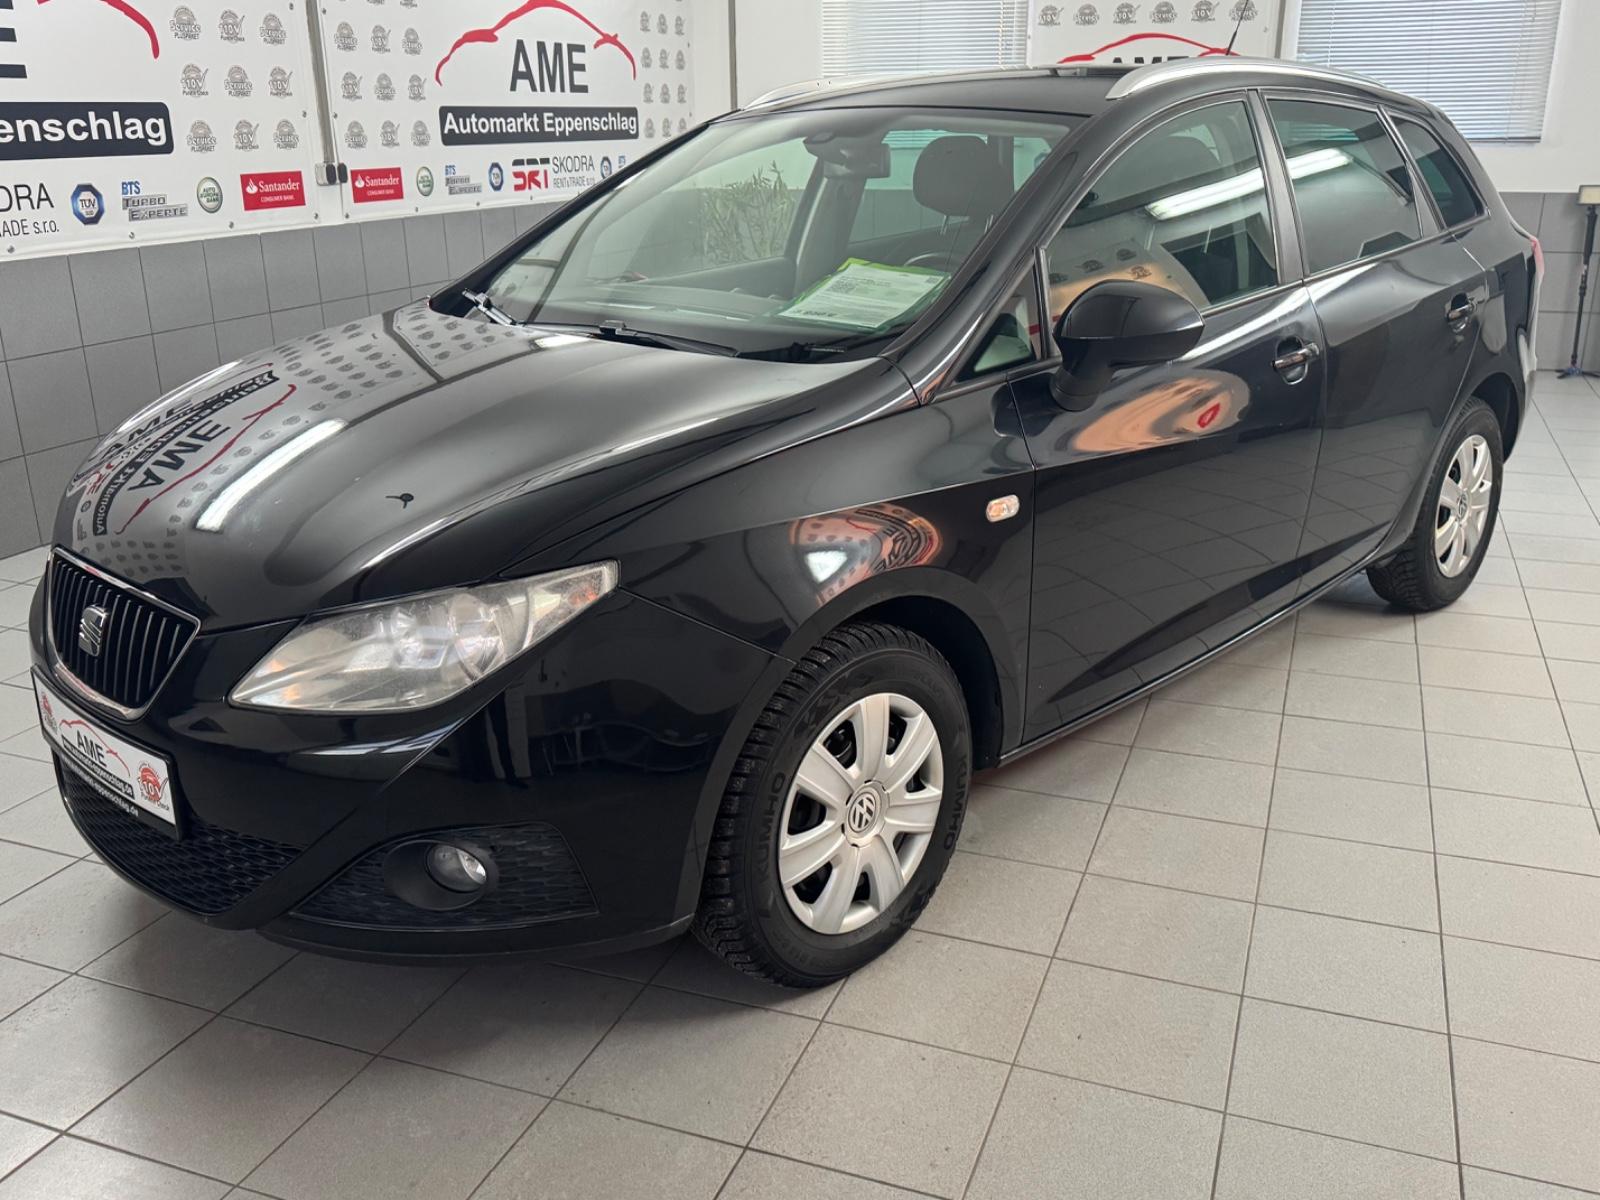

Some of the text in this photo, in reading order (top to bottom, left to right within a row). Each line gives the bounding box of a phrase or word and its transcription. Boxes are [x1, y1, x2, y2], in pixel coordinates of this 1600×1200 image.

[510, 39, 588, 93] AME
[443, 112, 539, 134] Automarkt
[543, 111, 637, 136] Eppenschlag
[552, 155, 595, 174] SKODRA
[121, 180, 140, 195] BTS
[258, 178, 300, 193] Santander
[365, 173, 400, 187] Santander
[0, 218, 29, 237] ADE
[77, 730, 107, 767] AME
